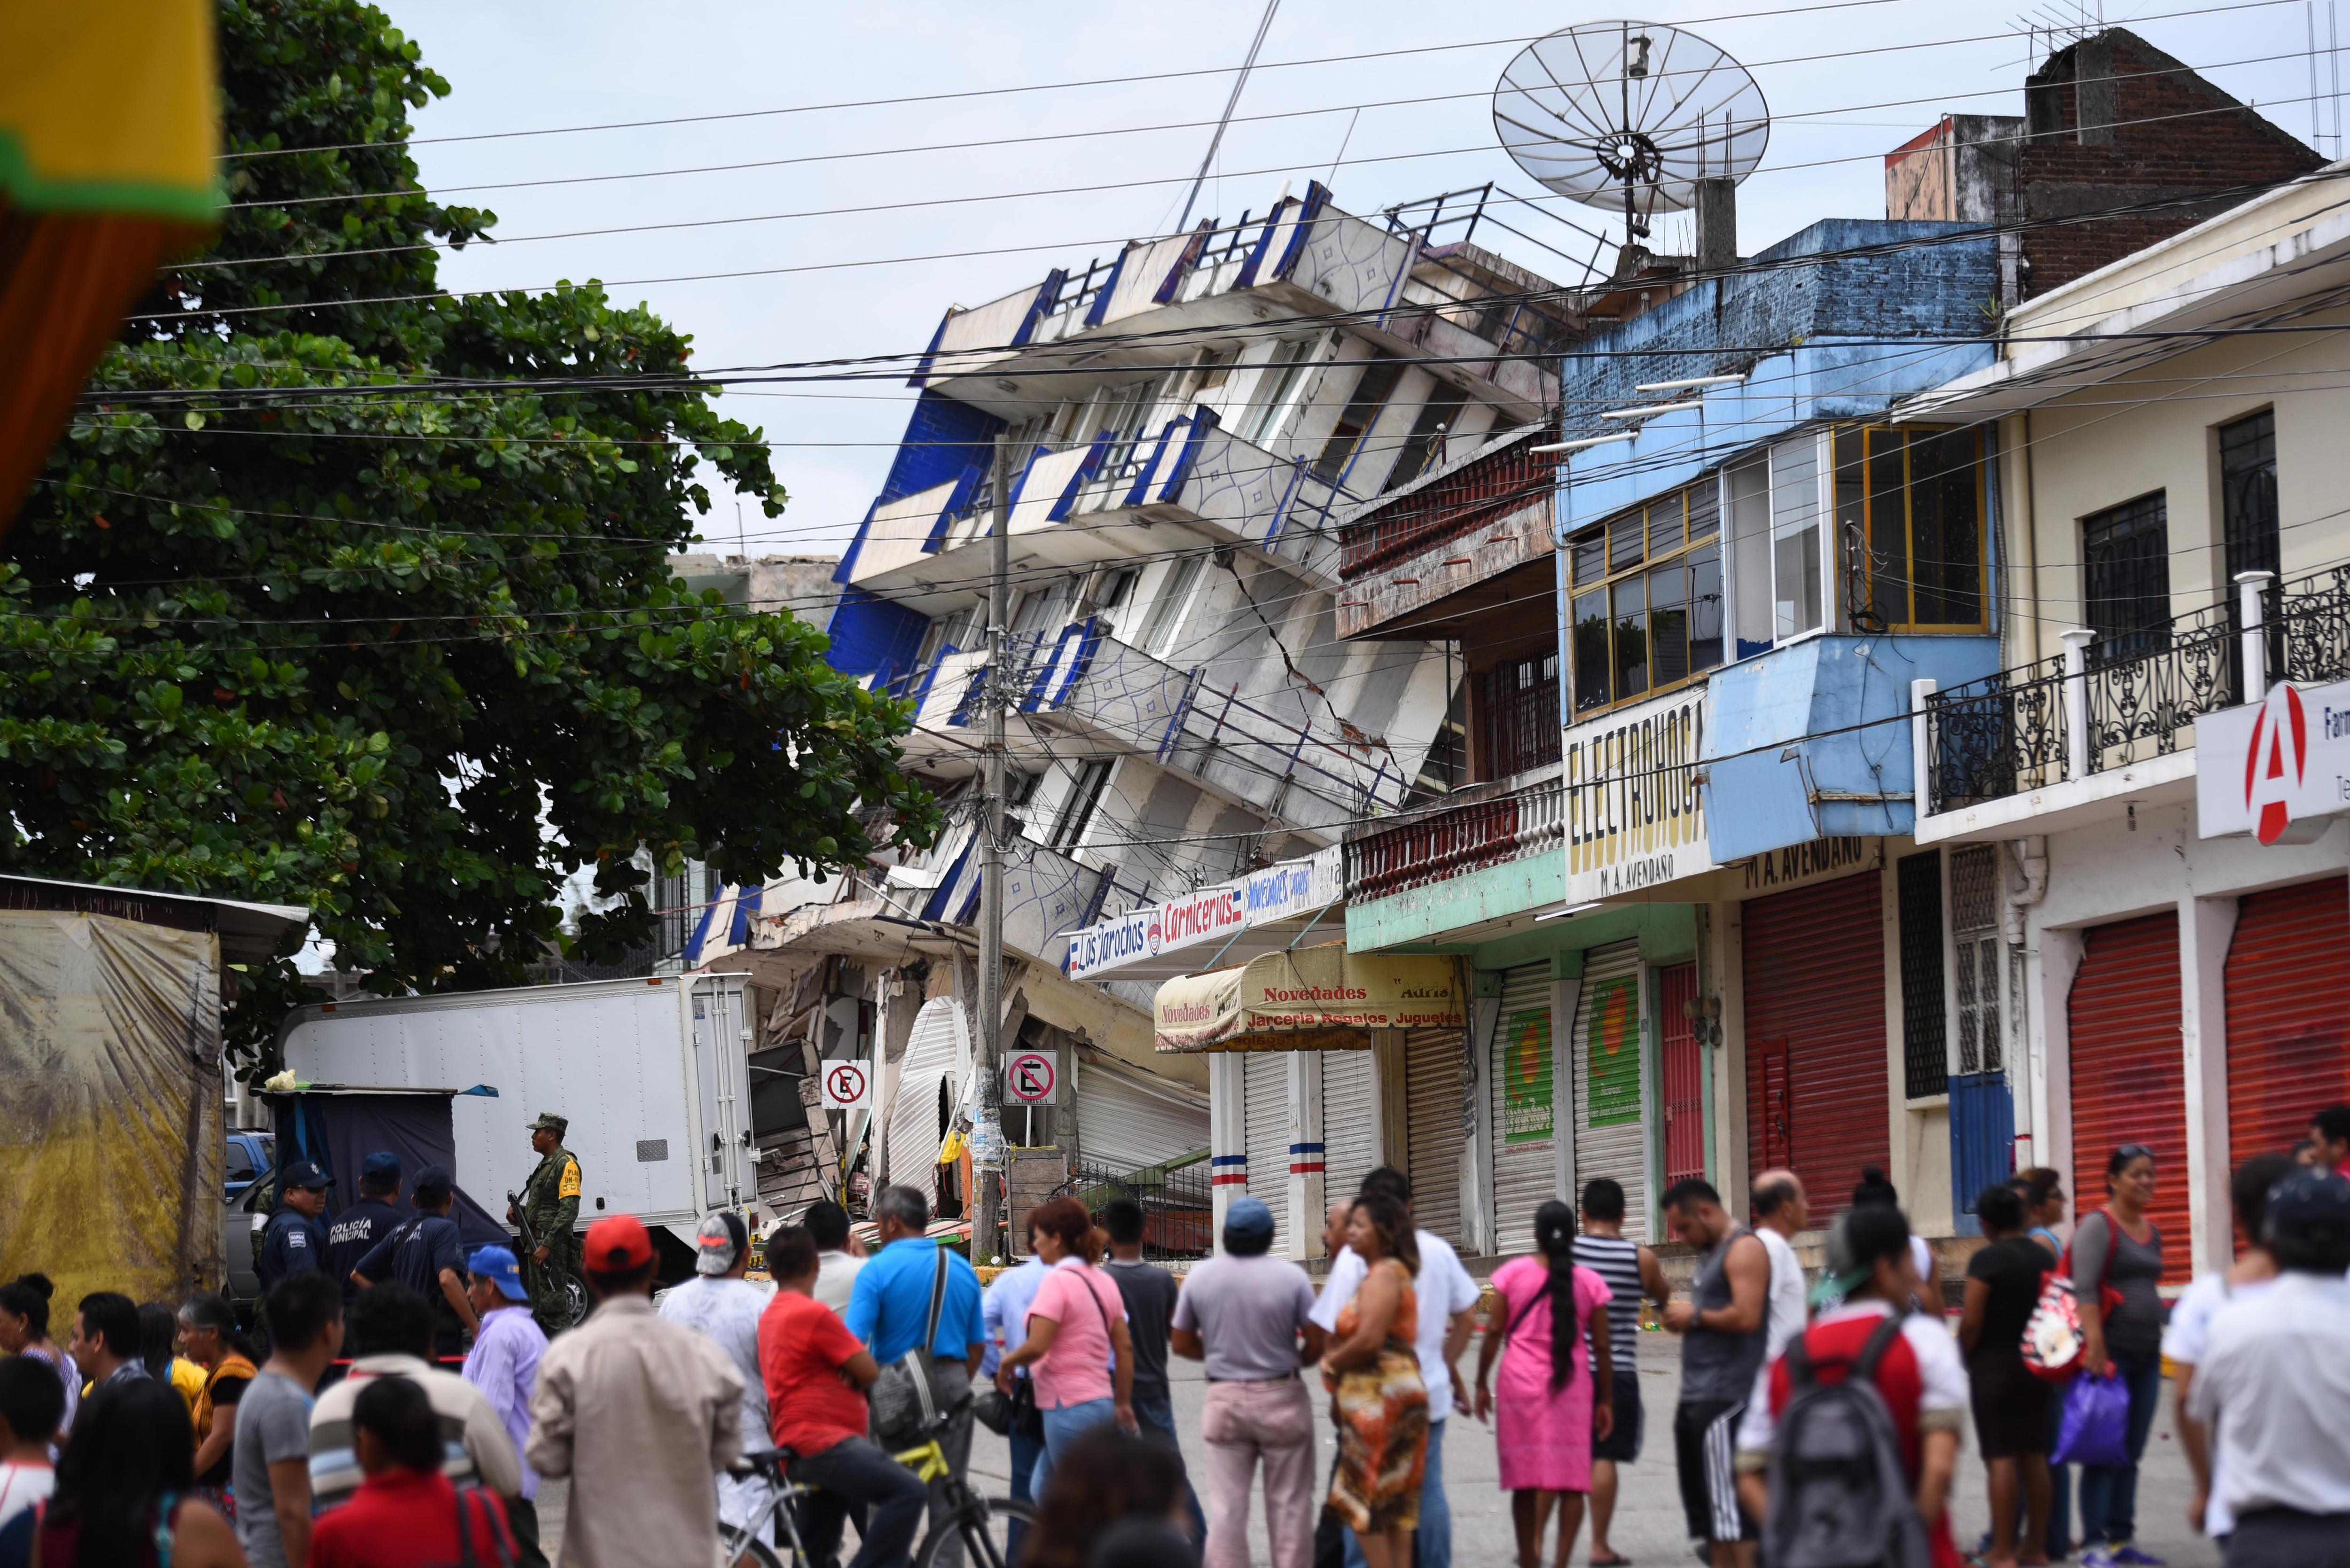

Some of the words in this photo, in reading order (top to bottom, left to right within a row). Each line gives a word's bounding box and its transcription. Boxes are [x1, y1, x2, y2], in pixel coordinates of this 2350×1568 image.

[1614, 866, 1623, 894] A.
[1626, 853, 1674, 891] AVENDAÑO
[1078, 934, 1096, 971] Los
[1264, 985, 1367, 1002] Novedades
[1161, 1002, 1210, 1023] Novedades
[1247, 1012, 1315, 1027] Jarceria
[1321, 1013, 1387, 1025] Regalos
[1395, 1012, 1462, 1025] Juguetes
[330, 1217, 371, 1236] POLICÍA
[329, 1229, 369, 1246] MUNICIPAL
